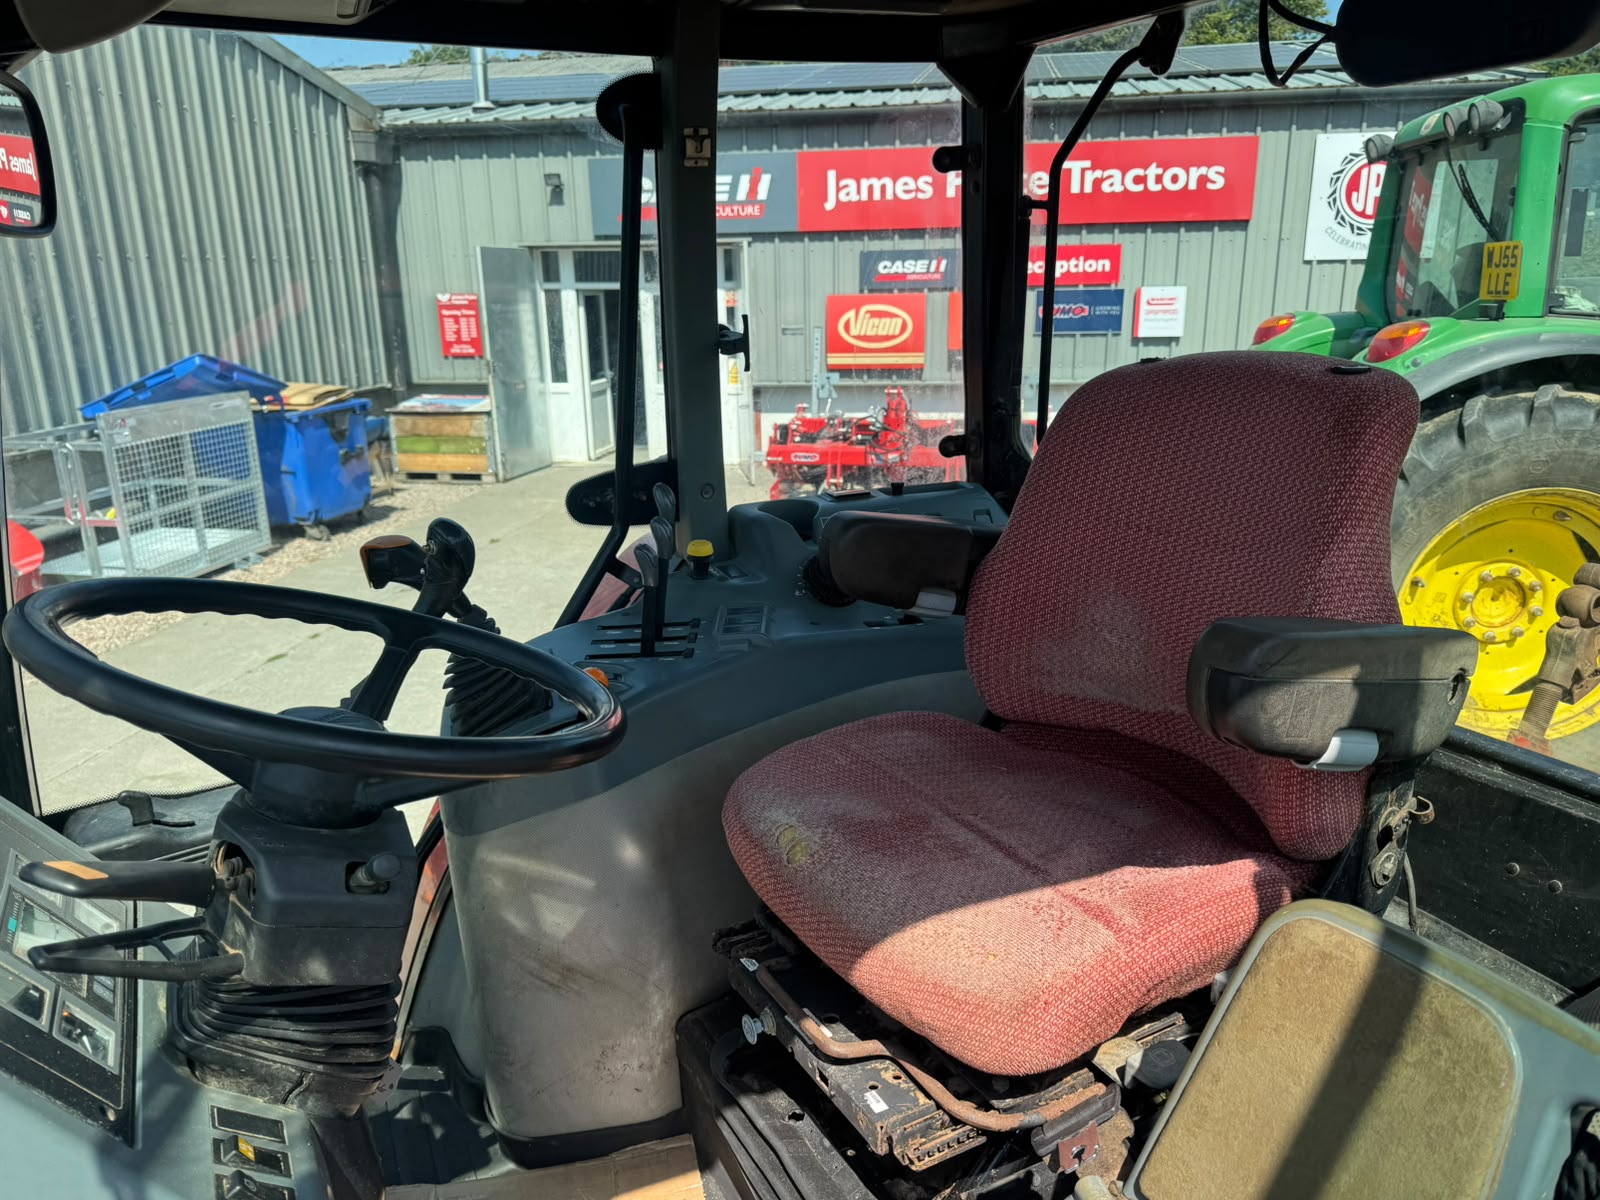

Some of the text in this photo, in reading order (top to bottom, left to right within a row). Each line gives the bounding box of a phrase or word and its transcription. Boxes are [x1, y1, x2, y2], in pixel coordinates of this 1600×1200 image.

[823, 169, 934, 212] James
[1062, 160, 1226, 194] Tractors
[878, 260, 930, 274] CASE
[1487, 244, 1519, 269] WJ55
[1487, 272, 1512, 295] LLE
[846, 305, 906, 339] Vicon
